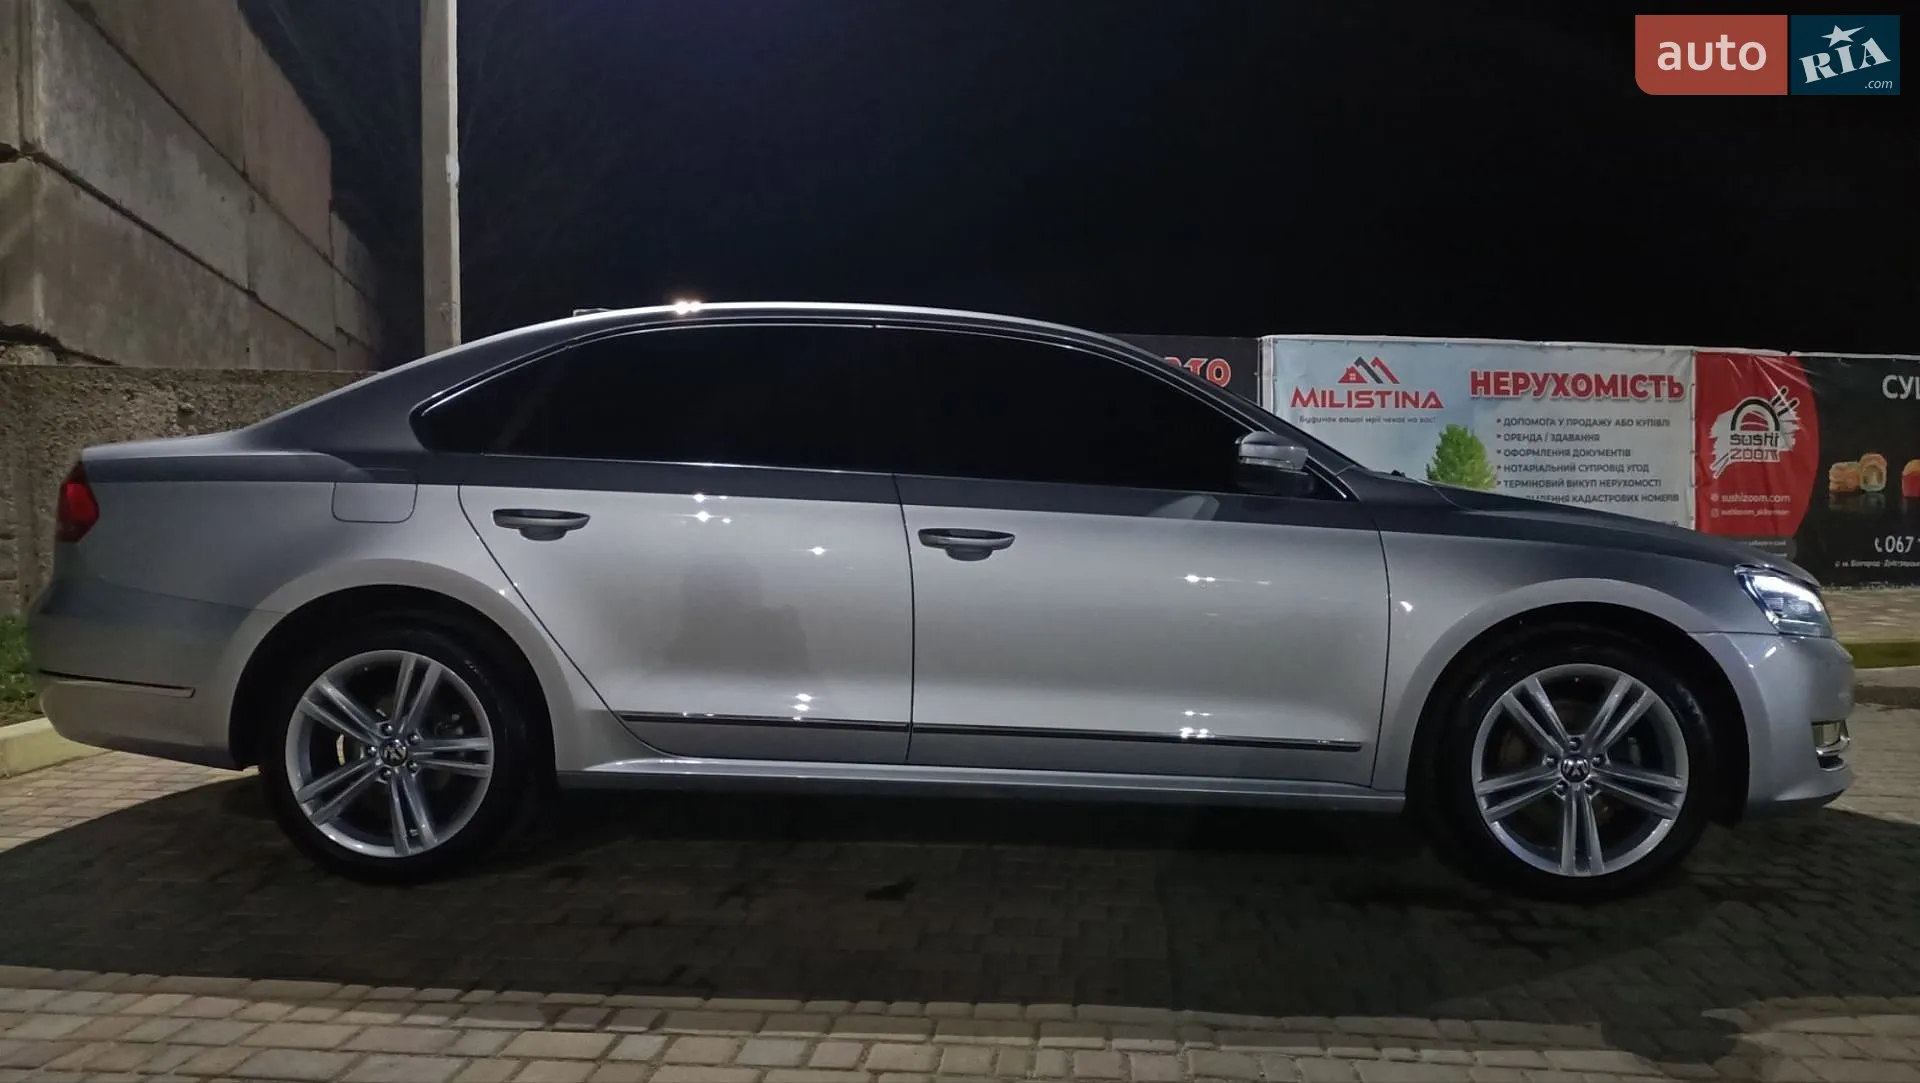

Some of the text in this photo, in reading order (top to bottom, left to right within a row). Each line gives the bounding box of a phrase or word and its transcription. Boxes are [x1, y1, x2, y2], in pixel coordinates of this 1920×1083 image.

[1164, 356, 1231, 388] ТО
[1470, 371, 1685, 399] НЕРУХОМІСТЬ
[1290, 386, 1445, 409] MILISTINA
[1503, 417, 1556, 427] ДОПОМОГА
[1558, 418, 1565, 426] У
[1566, 418, 1612, 427] ПРОДАЖУ
[1615, 419, 1634, 427] АБО
[1503, 433, 1542, 442] ОРЕНДА
[1550, 433, 1600, 442] ЗДАВАННЯ
[1503, 448, 1631, 458] ОФОРМЛЕННЯ ДОКУМЕНТІВ
[1503, 463, 1650, 473] НОТАРІАЛЬНИЙ СУПРОВІД УГОД
[1503, 479, 1662, 488] ТЕРМІНОВИЙ ВИКУП НЕРУХОМОСТІ
[1571, 495, 1640, 503] КАДАСТРОВИХ
[1885, 535, 1914, 553] 067
